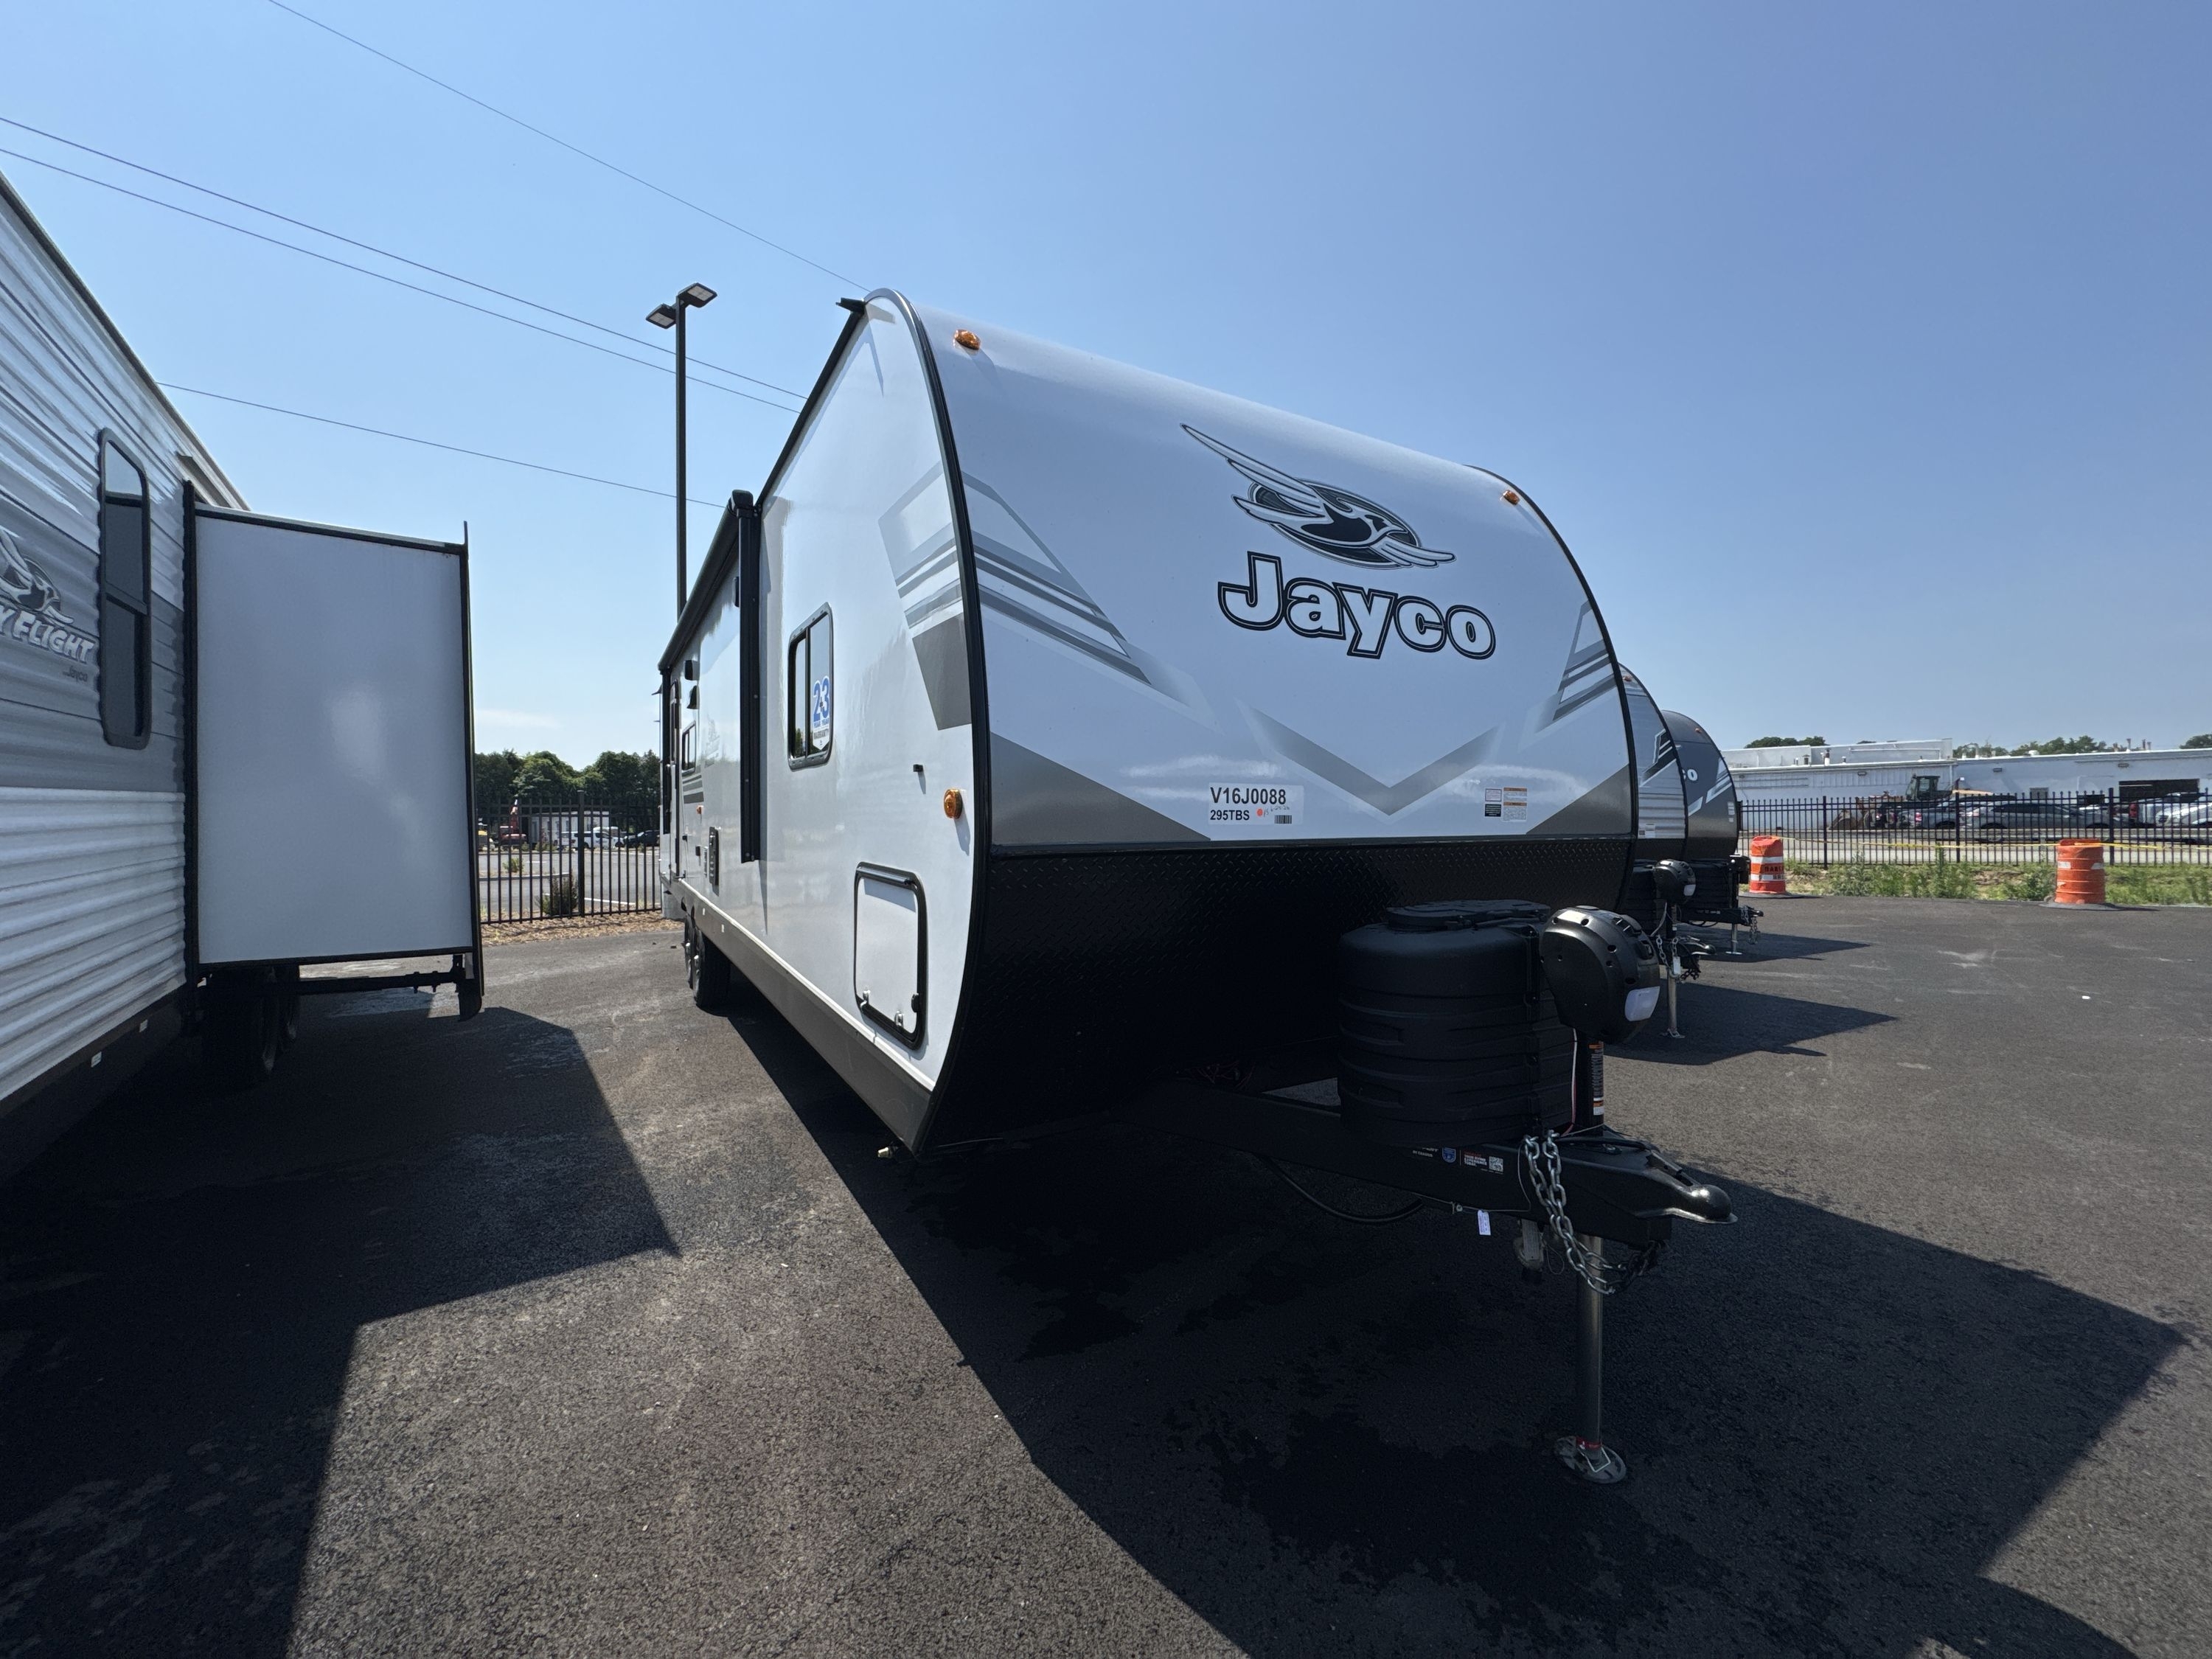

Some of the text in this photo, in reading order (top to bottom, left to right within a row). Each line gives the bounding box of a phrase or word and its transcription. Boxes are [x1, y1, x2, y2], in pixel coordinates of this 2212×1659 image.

[1217, 551, 1496, 660] Jayco
[13, 611, 95, 664] FLIGHT
[1210, 787, 1286, 804] V16J0088
[1210, 810, 1250, 821] 295TBS
